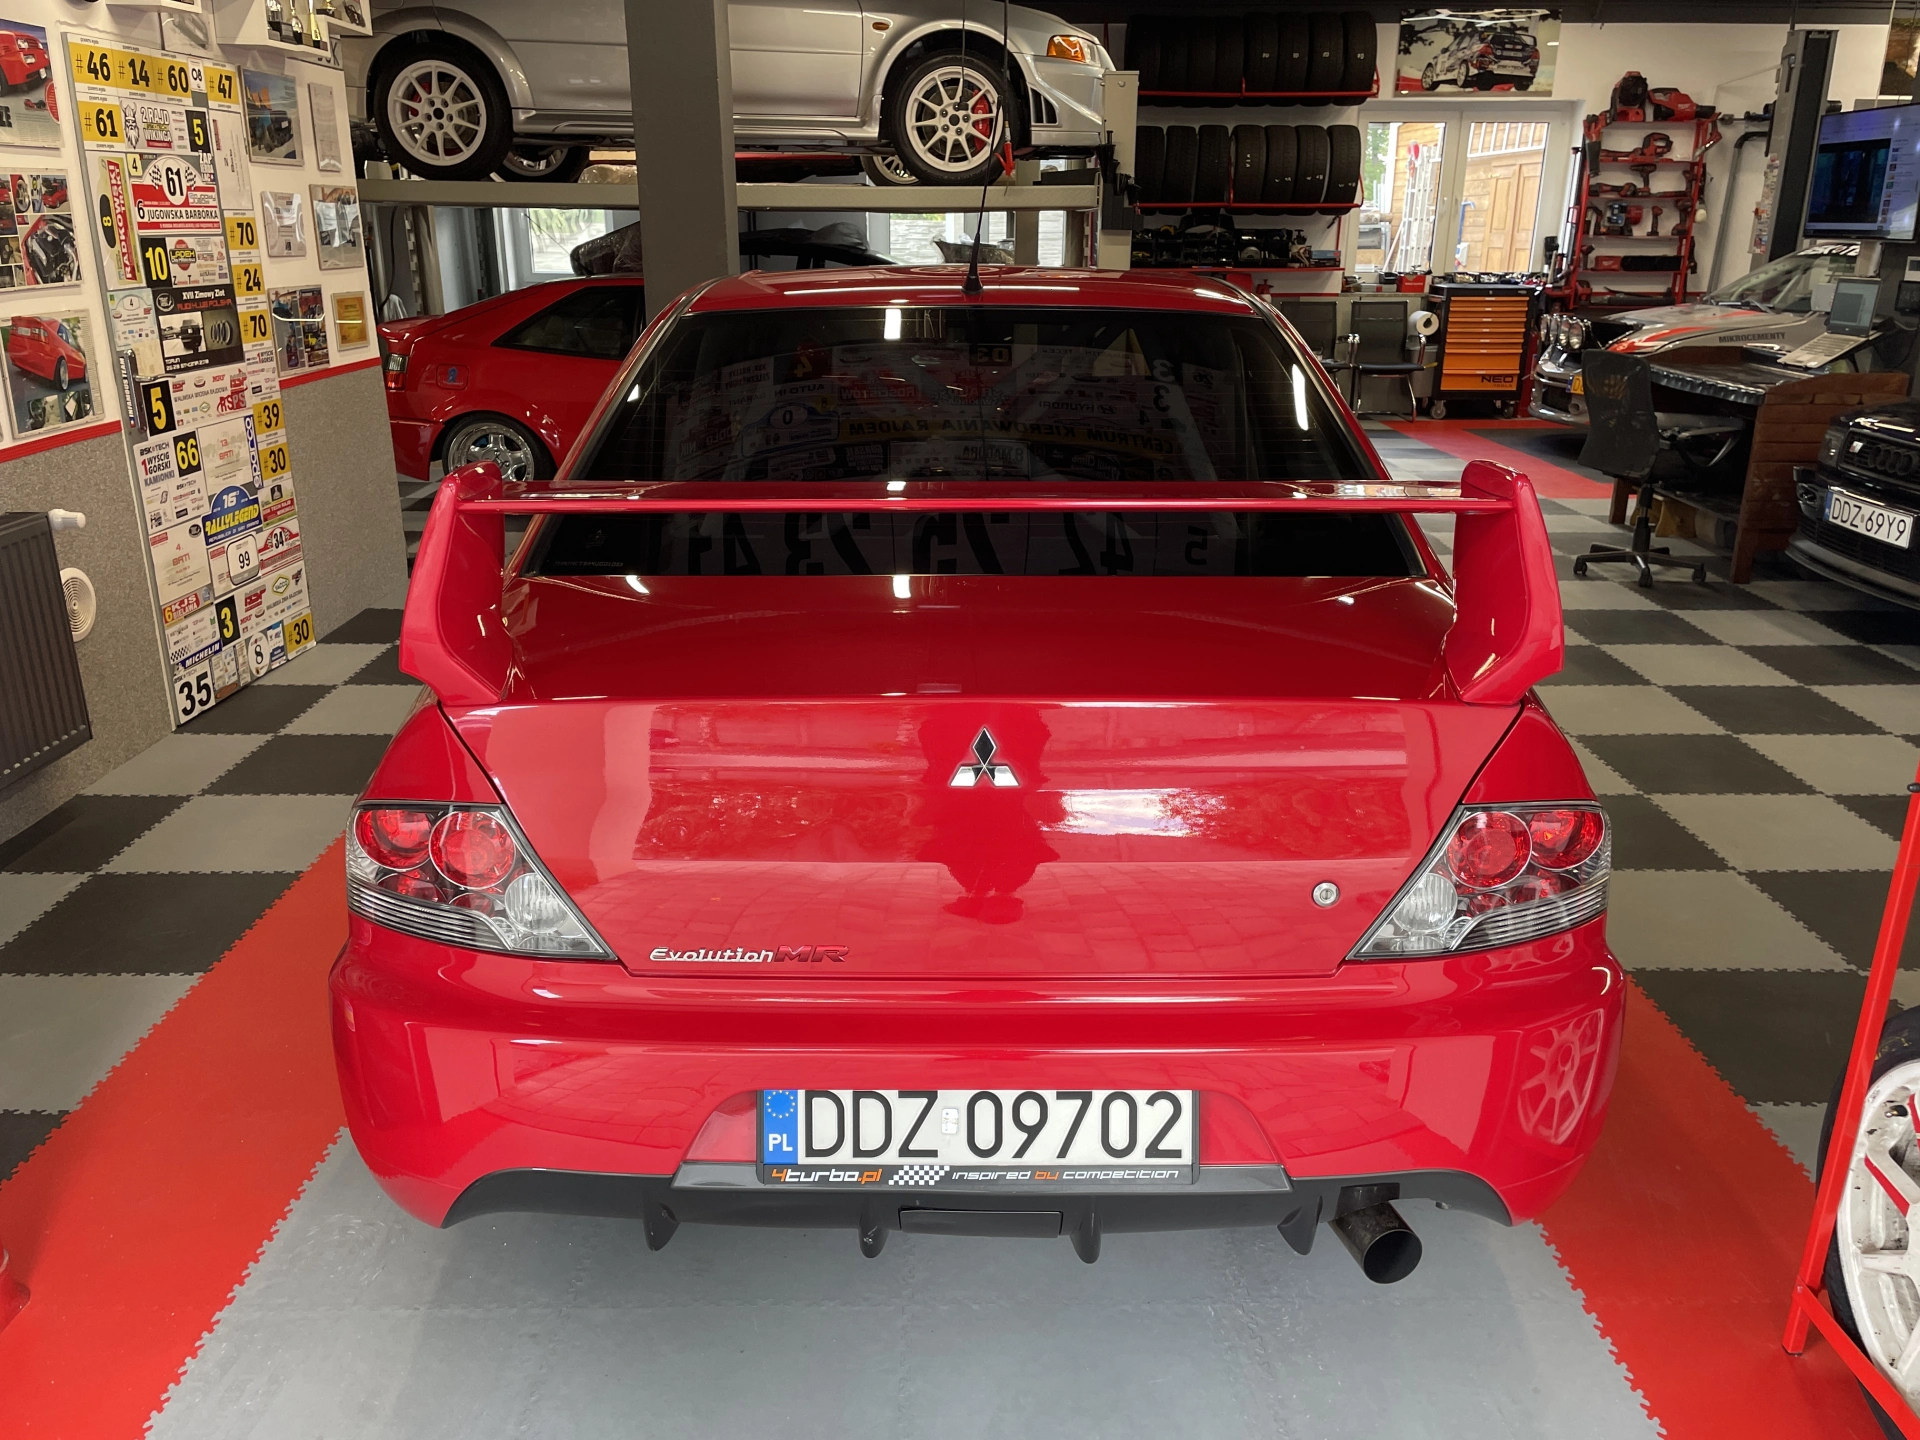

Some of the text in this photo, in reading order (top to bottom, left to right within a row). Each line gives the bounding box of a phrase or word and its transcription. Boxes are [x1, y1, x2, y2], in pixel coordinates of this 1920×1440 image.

[143, 129, 173, 142] WIKINGA
[192, 118, 204, 146] 5
[132, 157, 138, 172] 4
[165, 166, 185, 197] 61
[102, 216, 112, 226] 8
[108, 164, 133, 279] RADKOWSKI
[137, 200, 145, 220] 6
[147, 209, 184, 222] JUGOWSKA
[185, 206, 219, 220] BARBÓRKA
[145, 246, 168, 281] 10
[1718, 332, 1786, 343] MIKROCEMENTY
[119, 357, 135, 417] INFAMOUS TEAM
[1481, 375, 1515, 383] NEO
[150, 386, 167, 430] 5
[176, 438, 199, 470] 66
[141, 458, 149, 476] 1
[205, 503, 259, 536] RALLYLEGEND
[1831, 497, 1907, 541] DDZ 69Y9
[273, 530, 285, 549] 34
[238, 550, 251, 569] 99
[164, 594, 197, 622] 6 KJS
[173, 602, 198, 620] BIELAWA
[220, 606, 234, 639] 3
[185, 641, 220, 668] MICHELIN
[254, 644, 264, 665] 8
[178, 670, 212, 717] 35
[650, 944, 850, 963] Evolution MR
[805, 1090, 1182, 1159] DDZ 09702
[768, 1133, 793, 1152] PL
[771, 1168, 883, 1184] 4turbo.pl
[951, 1169, 1179, 1181] inspired by competition
